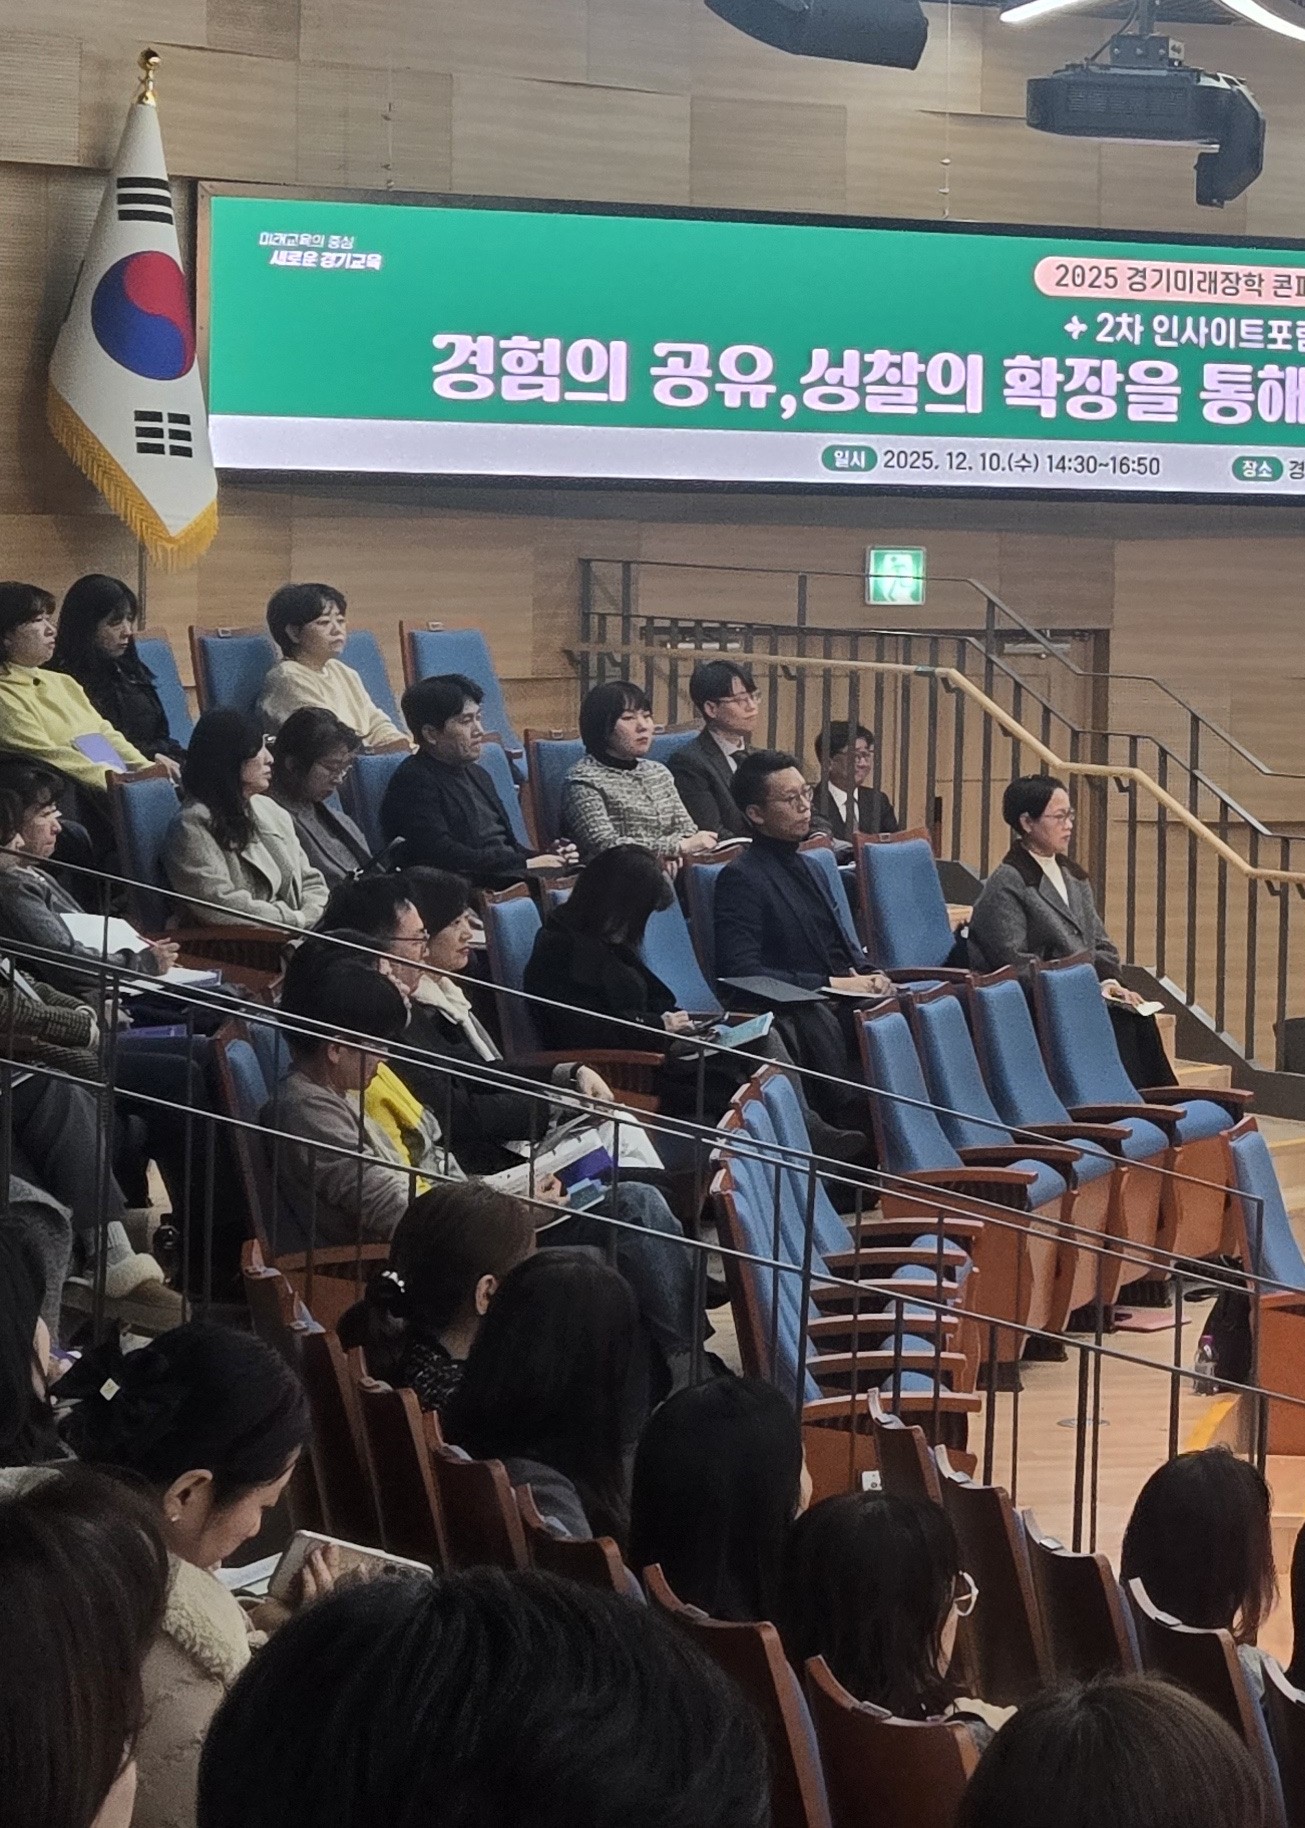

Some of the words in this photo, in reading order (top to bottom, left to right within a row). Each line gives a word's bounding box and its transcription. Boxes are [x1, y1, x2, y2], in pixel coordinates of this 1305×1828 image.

[270, 250, 318, 267] 새로운
[320, 252, 382, 270] 경기교육
[1056, 264, 1118, 289] 2025
[1127, 266, 1265, 297] 경기미래장학
[1096, 312, 1144, 346] 2차
[432, 334, 629, 403] 경험의
[1003, 349, 1183, 424] 확장을
[834, 450, 866, 469] 일시
[884, 450, 938, 469] 2025.
[947, 452, 973, 471] 12.
[980, 452, 1039, 473] 10.(수)
[1047, 454, 1160, 476] 14:30~16:50
[1242, 460, 1273, 479] 장소
